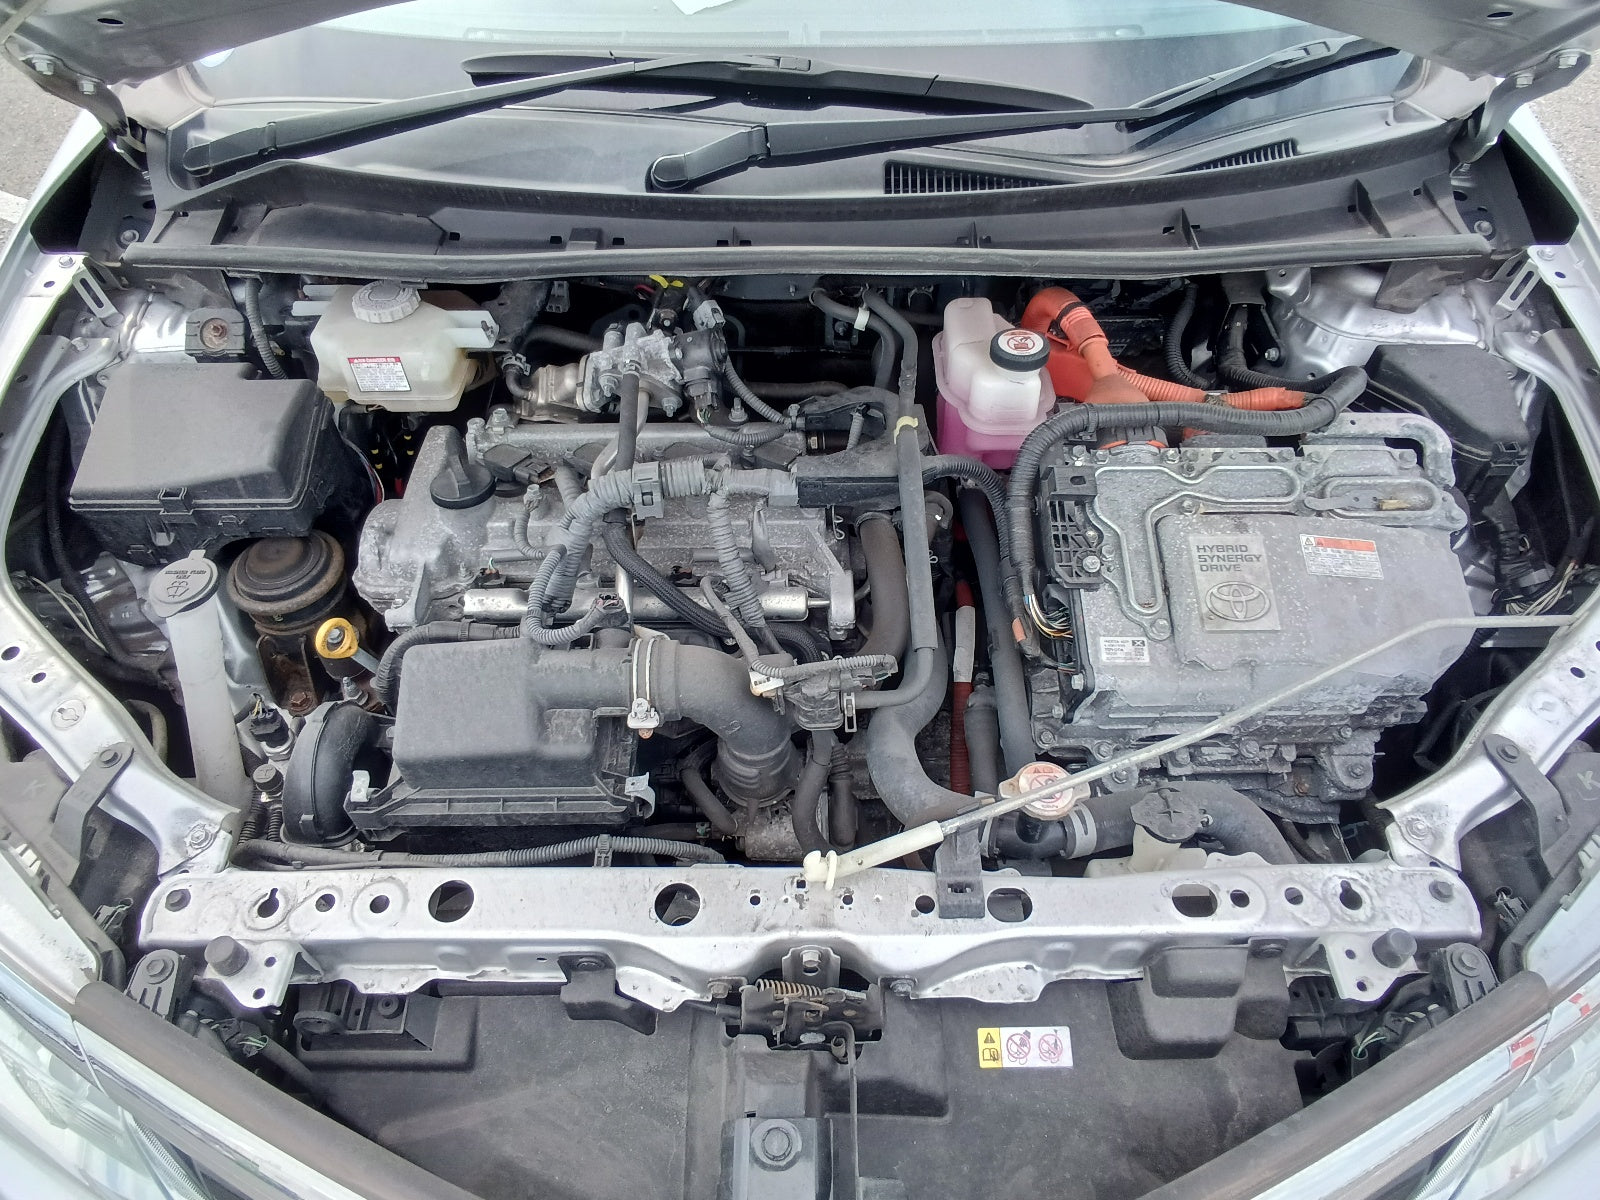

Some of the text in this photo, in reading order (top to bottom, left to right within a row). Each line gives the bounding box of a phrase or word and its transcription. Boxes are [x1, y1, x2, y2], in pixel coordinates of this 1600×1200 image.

[1196, 544, 1249, 553] HYBRID
[1198, 554, 1262, 563] SYNERGY
[1200, 564, 1242, 572] DRIVE
